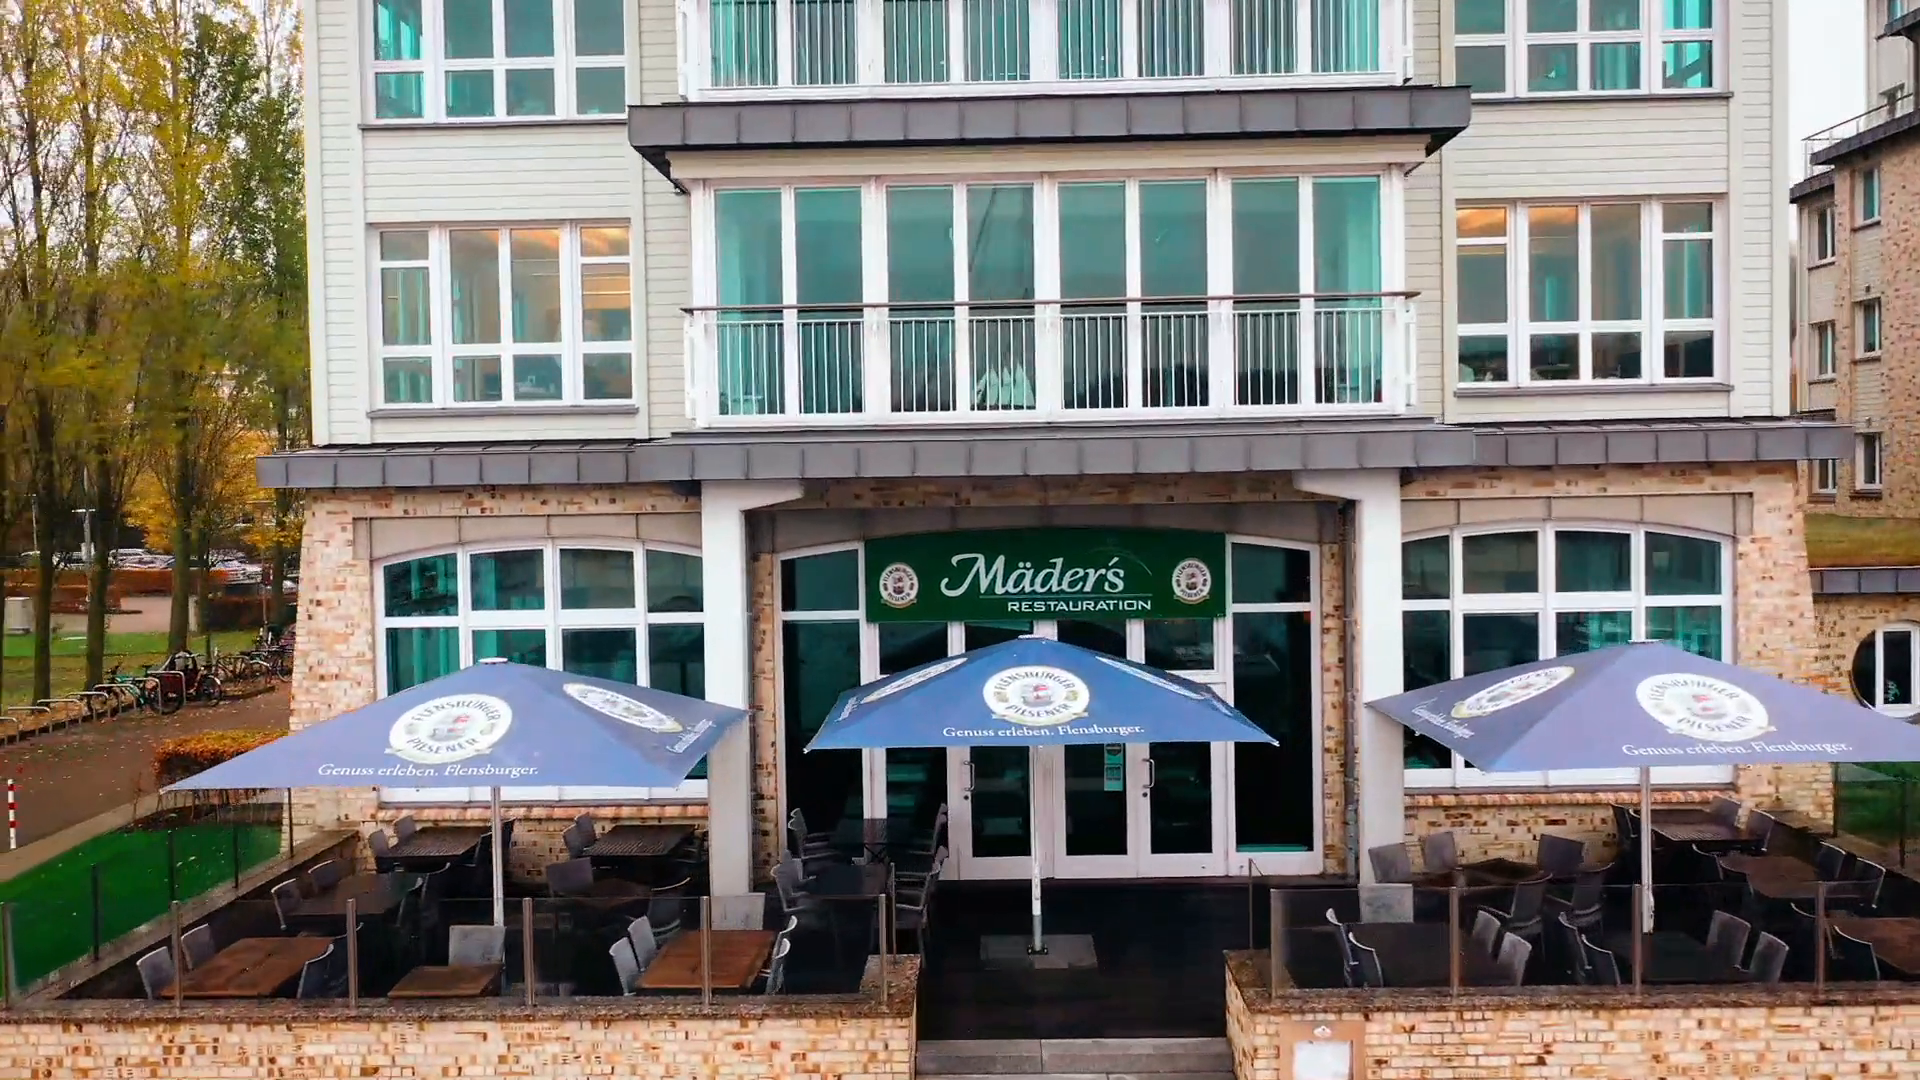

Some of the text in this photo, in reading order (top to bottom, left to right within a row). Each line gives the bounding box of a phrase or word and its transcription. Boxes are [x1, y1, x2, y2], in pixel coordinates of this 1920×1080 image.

[1007, 600, 1151, 612] RESTAURATION
[994, 671, 1075, 691] FLENSBURGER
[1005, 702, 1073, 718] PILSENER
[943, 723, 1145, 738] Genuss erleben. Flensburger.
[1622, 744, 1684, 756] Genuss
[1750, 740, 1853, 754] Flensburger.
[318, 764, 539, 778] Genuss erleben. Flensburger.
